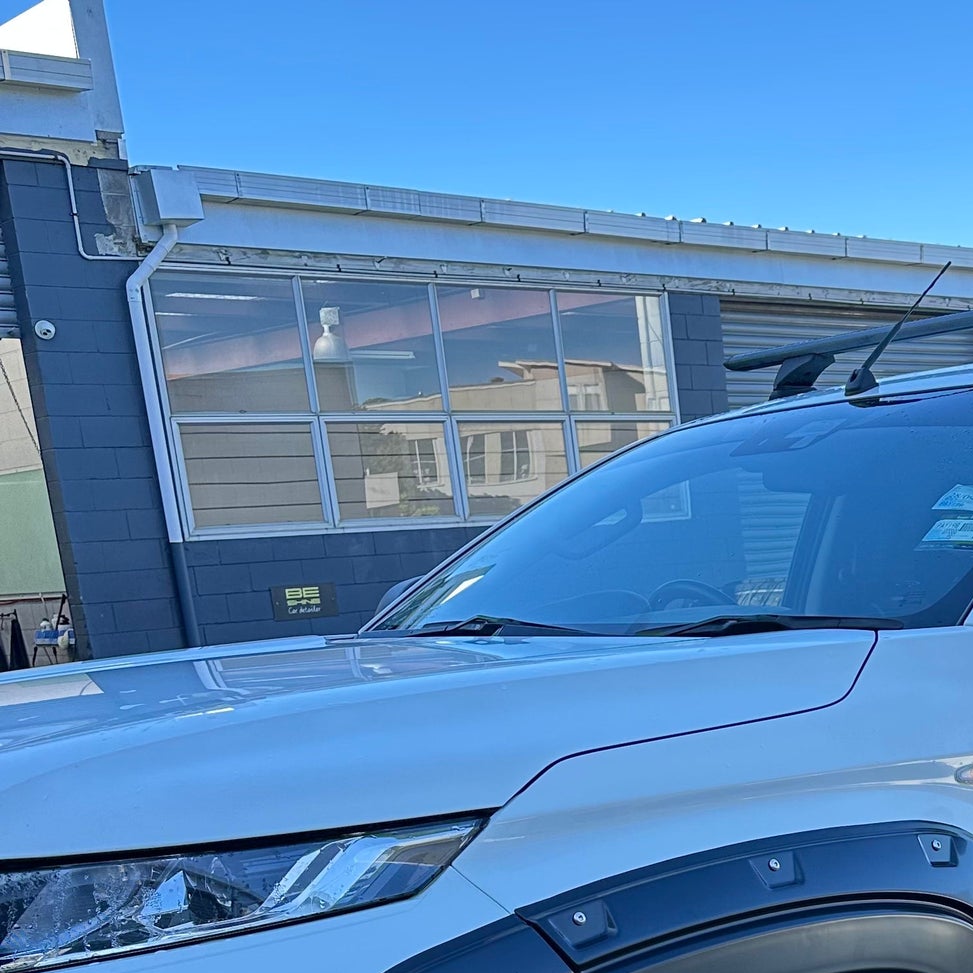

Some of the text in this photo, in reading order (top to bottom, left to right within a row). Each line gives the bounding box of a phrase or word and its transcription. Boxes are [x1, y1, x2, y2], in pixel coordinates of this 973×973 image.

[285, 586, 320, 599] BE
[287, 598, 321, 606] SHINE
[288, 606, 298, 614] Car
